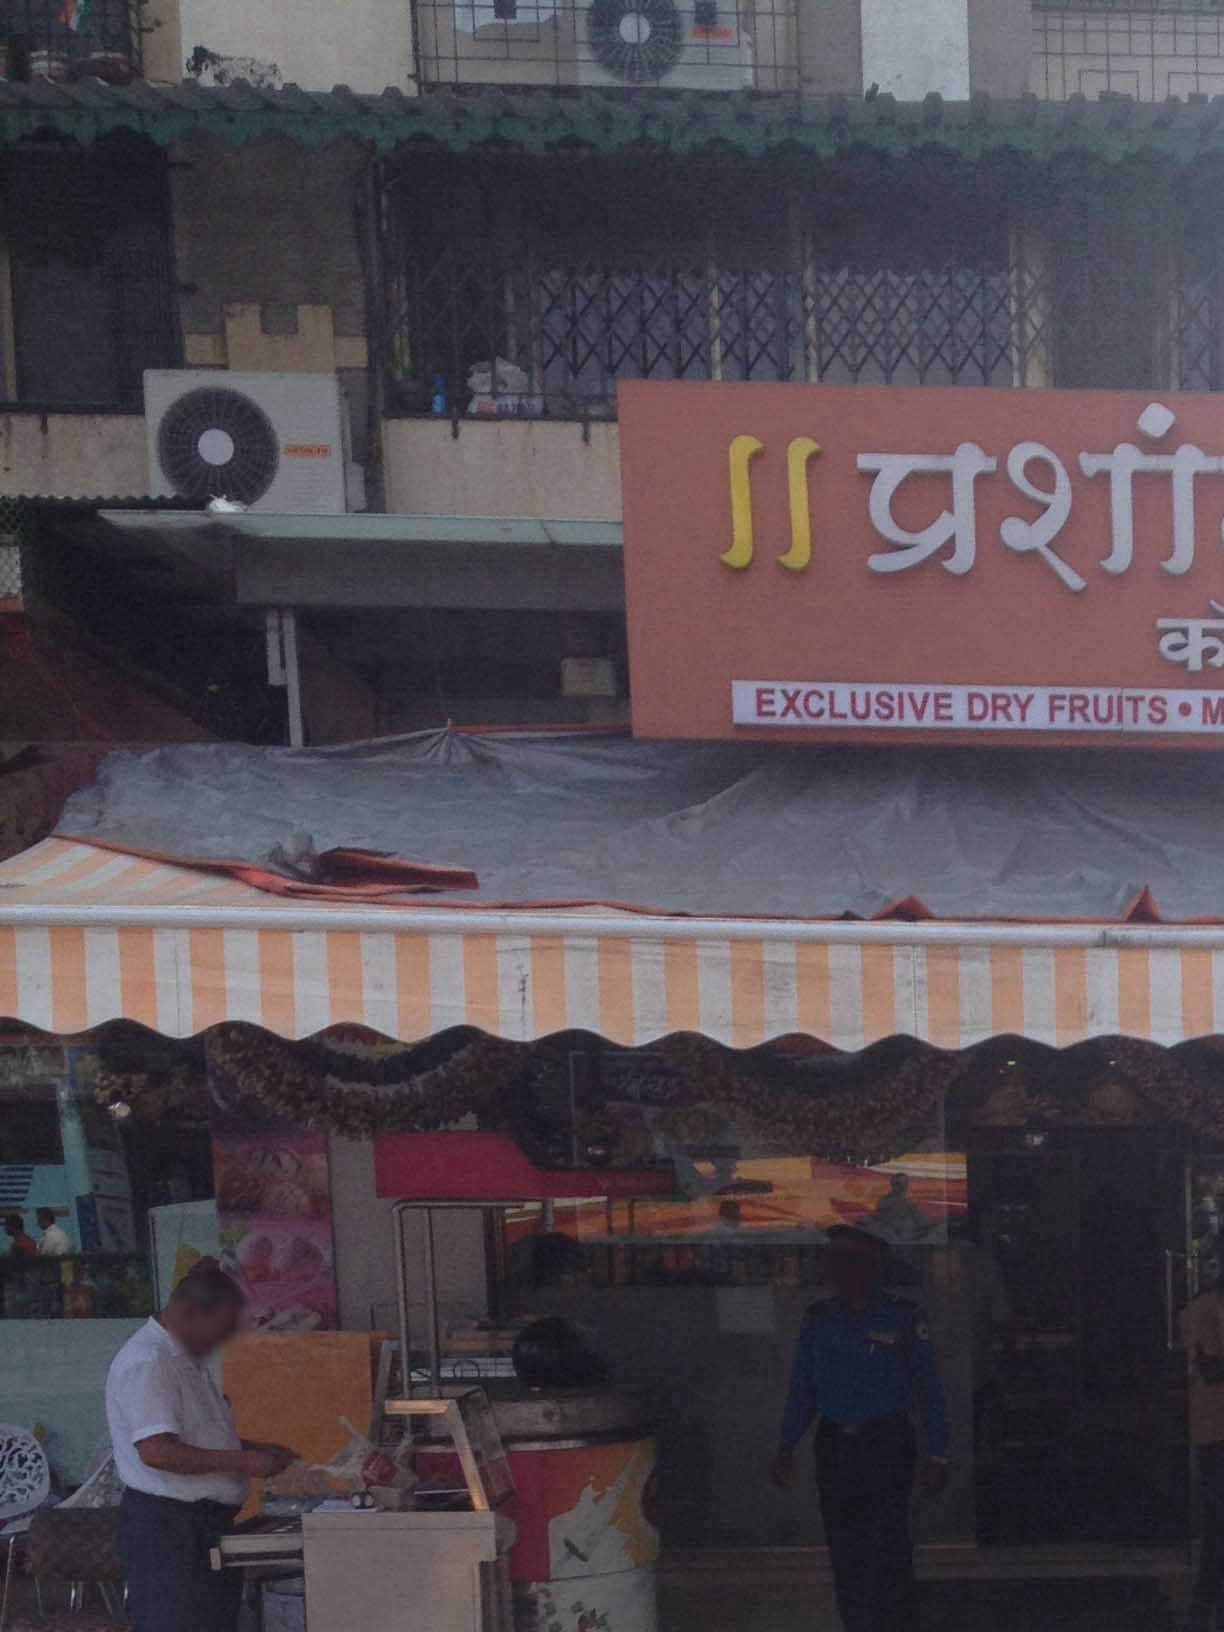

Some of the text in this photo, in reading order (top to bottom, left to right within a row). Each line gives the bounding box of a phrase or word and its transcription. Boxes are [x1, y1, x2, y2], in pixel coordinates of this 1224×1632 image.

[755, 687, 953, 722] EXCLUSIVE
[967, 692, 1036, 722] DRY
[1048, 694, 1168, 725] FRUITS
